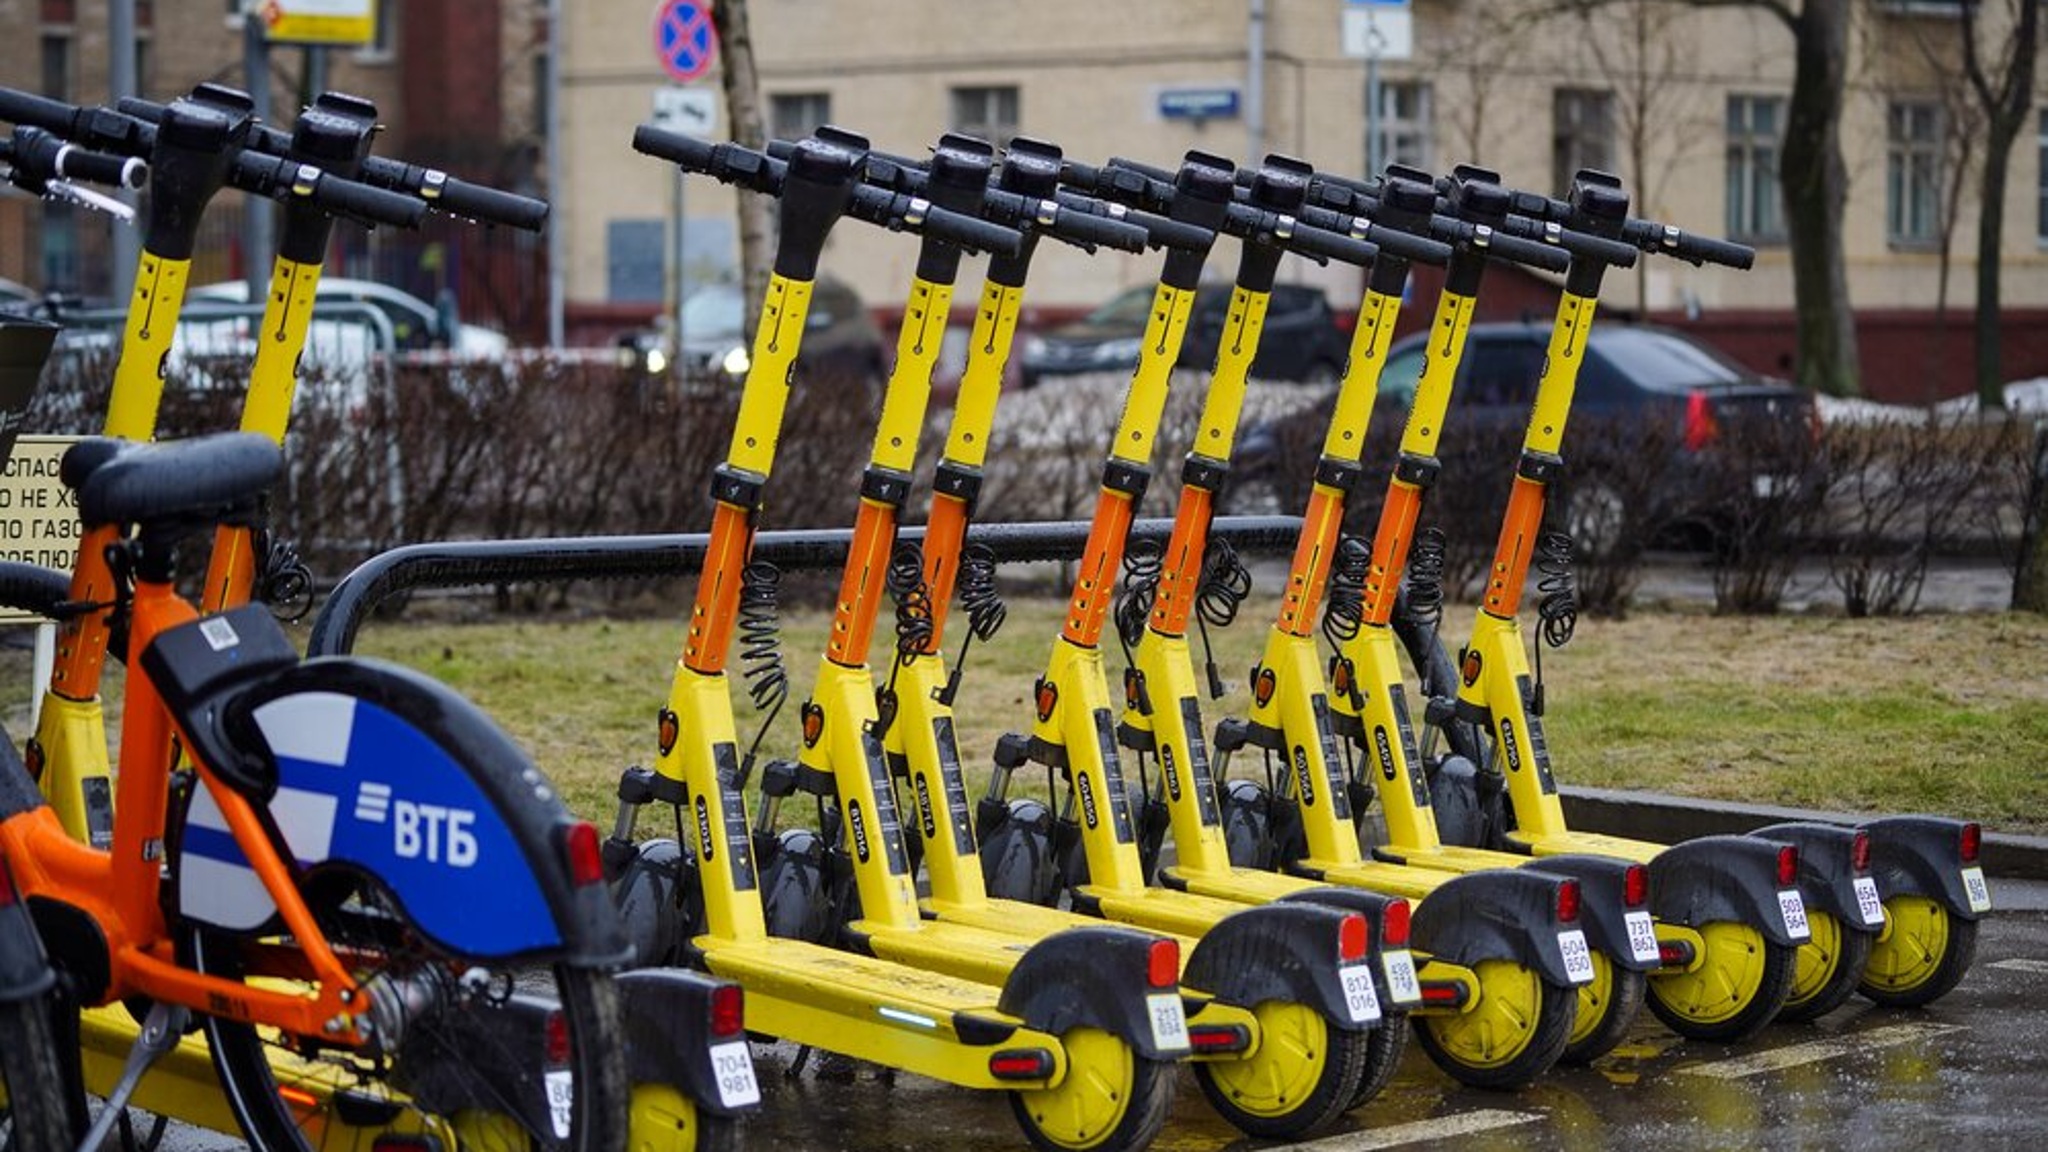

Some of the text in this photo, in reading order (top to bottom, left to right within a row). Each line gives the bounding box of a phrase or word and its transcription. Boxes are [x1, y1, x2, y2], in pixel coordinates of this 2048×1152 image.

[21, 489, 48, 508] НЕ
[1079, 775, 1096, 825] 604850
[394, 799, 478, 868] ВТБ
[850, 807, 867, 856] 812016
[1857, 886, 1877, 900] 654
[1781, 897, 1802, 914] 503
[1862, 900, 1880, 914] 577
[1630, 920, 1650, 936] 737
[1785, 913, 1805, 929] 564
[1562, 939, 1585, 956] 604
[1633, 935, 1655, 952] 862
[1566, 955, 1590, 972] 850
[1346, 974, 1371, 992] 812
[1350, 992, 1376, 1011] 016
[716, 1054, 748, 1074] 704
[722, 1074, 752, 1095] 981
